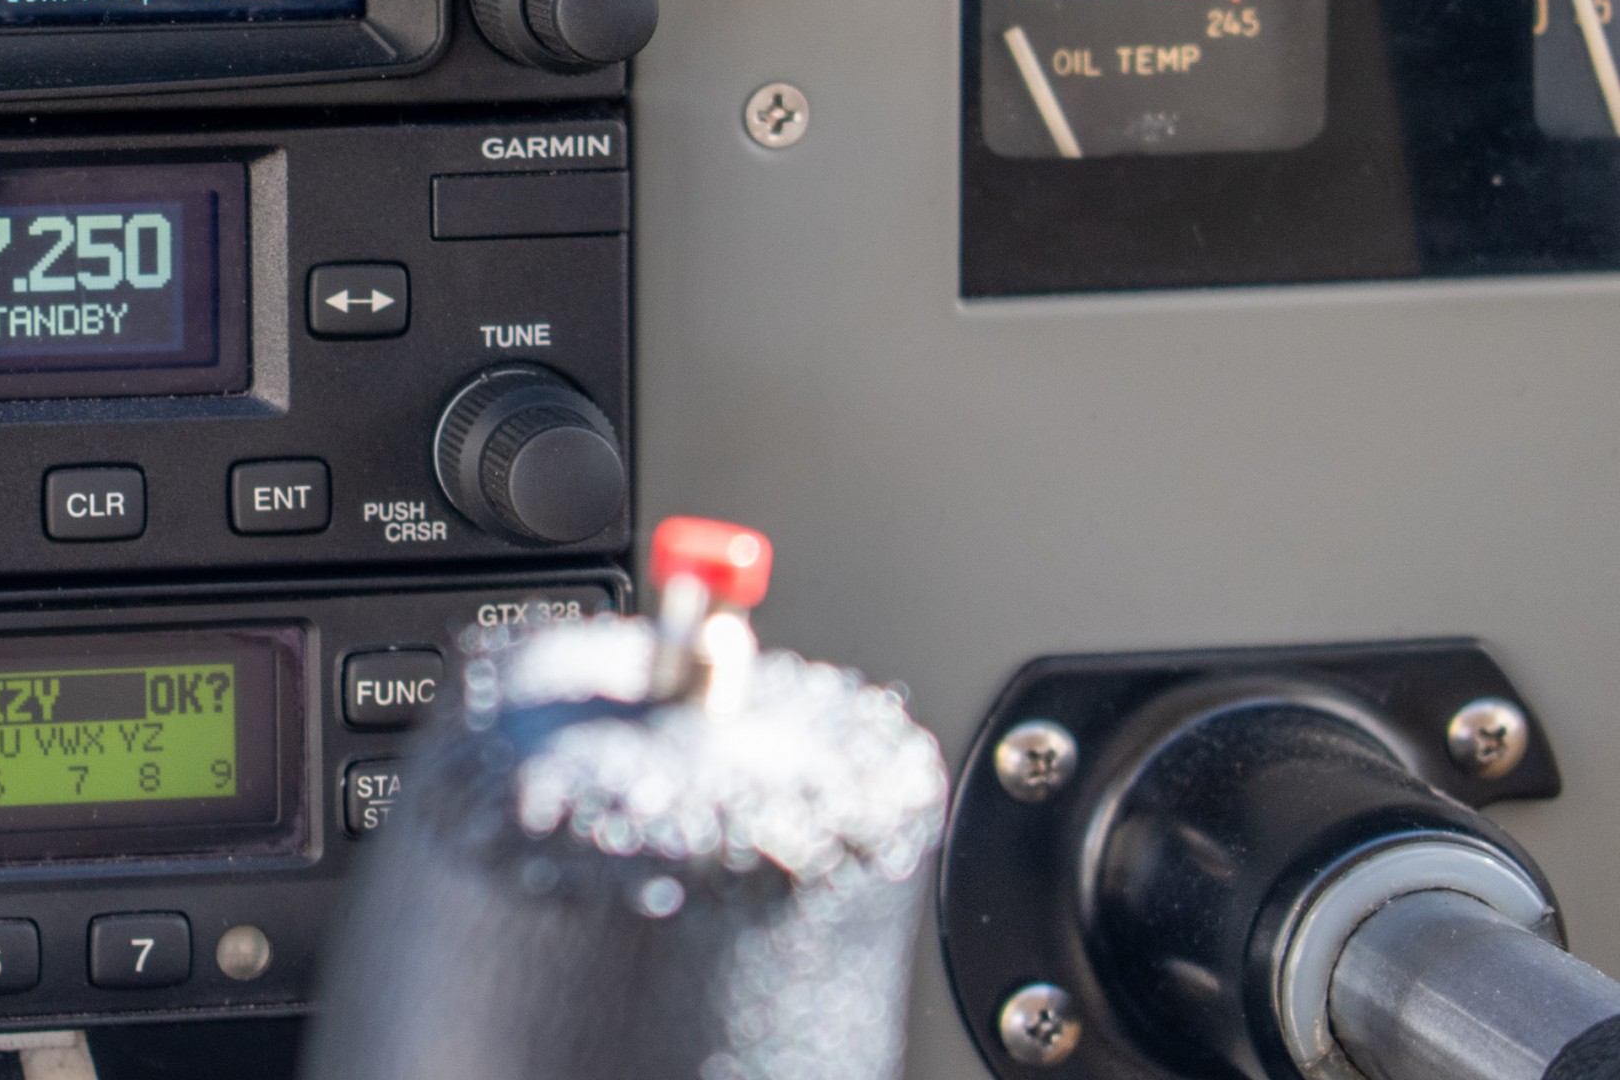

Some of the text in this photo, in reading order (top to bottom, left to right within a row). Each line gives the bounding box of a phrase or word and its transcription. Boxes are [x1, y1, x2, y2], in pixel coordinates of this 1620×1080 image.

[1207, 9, 1260, 38] 245
[1053, 45, 1202, 76] OIL TEMP
[481, 136, 610, 159] GARMIN
[481, 324, 551, 347] TUNE
[66, 493, 125, 518] CLR
[254, 486, 311, 511] ENT
[364, 502, 425, 522] PUSH
[385, 522, 447, 542] CRSR
[149, 672, 230, 715] OK?
